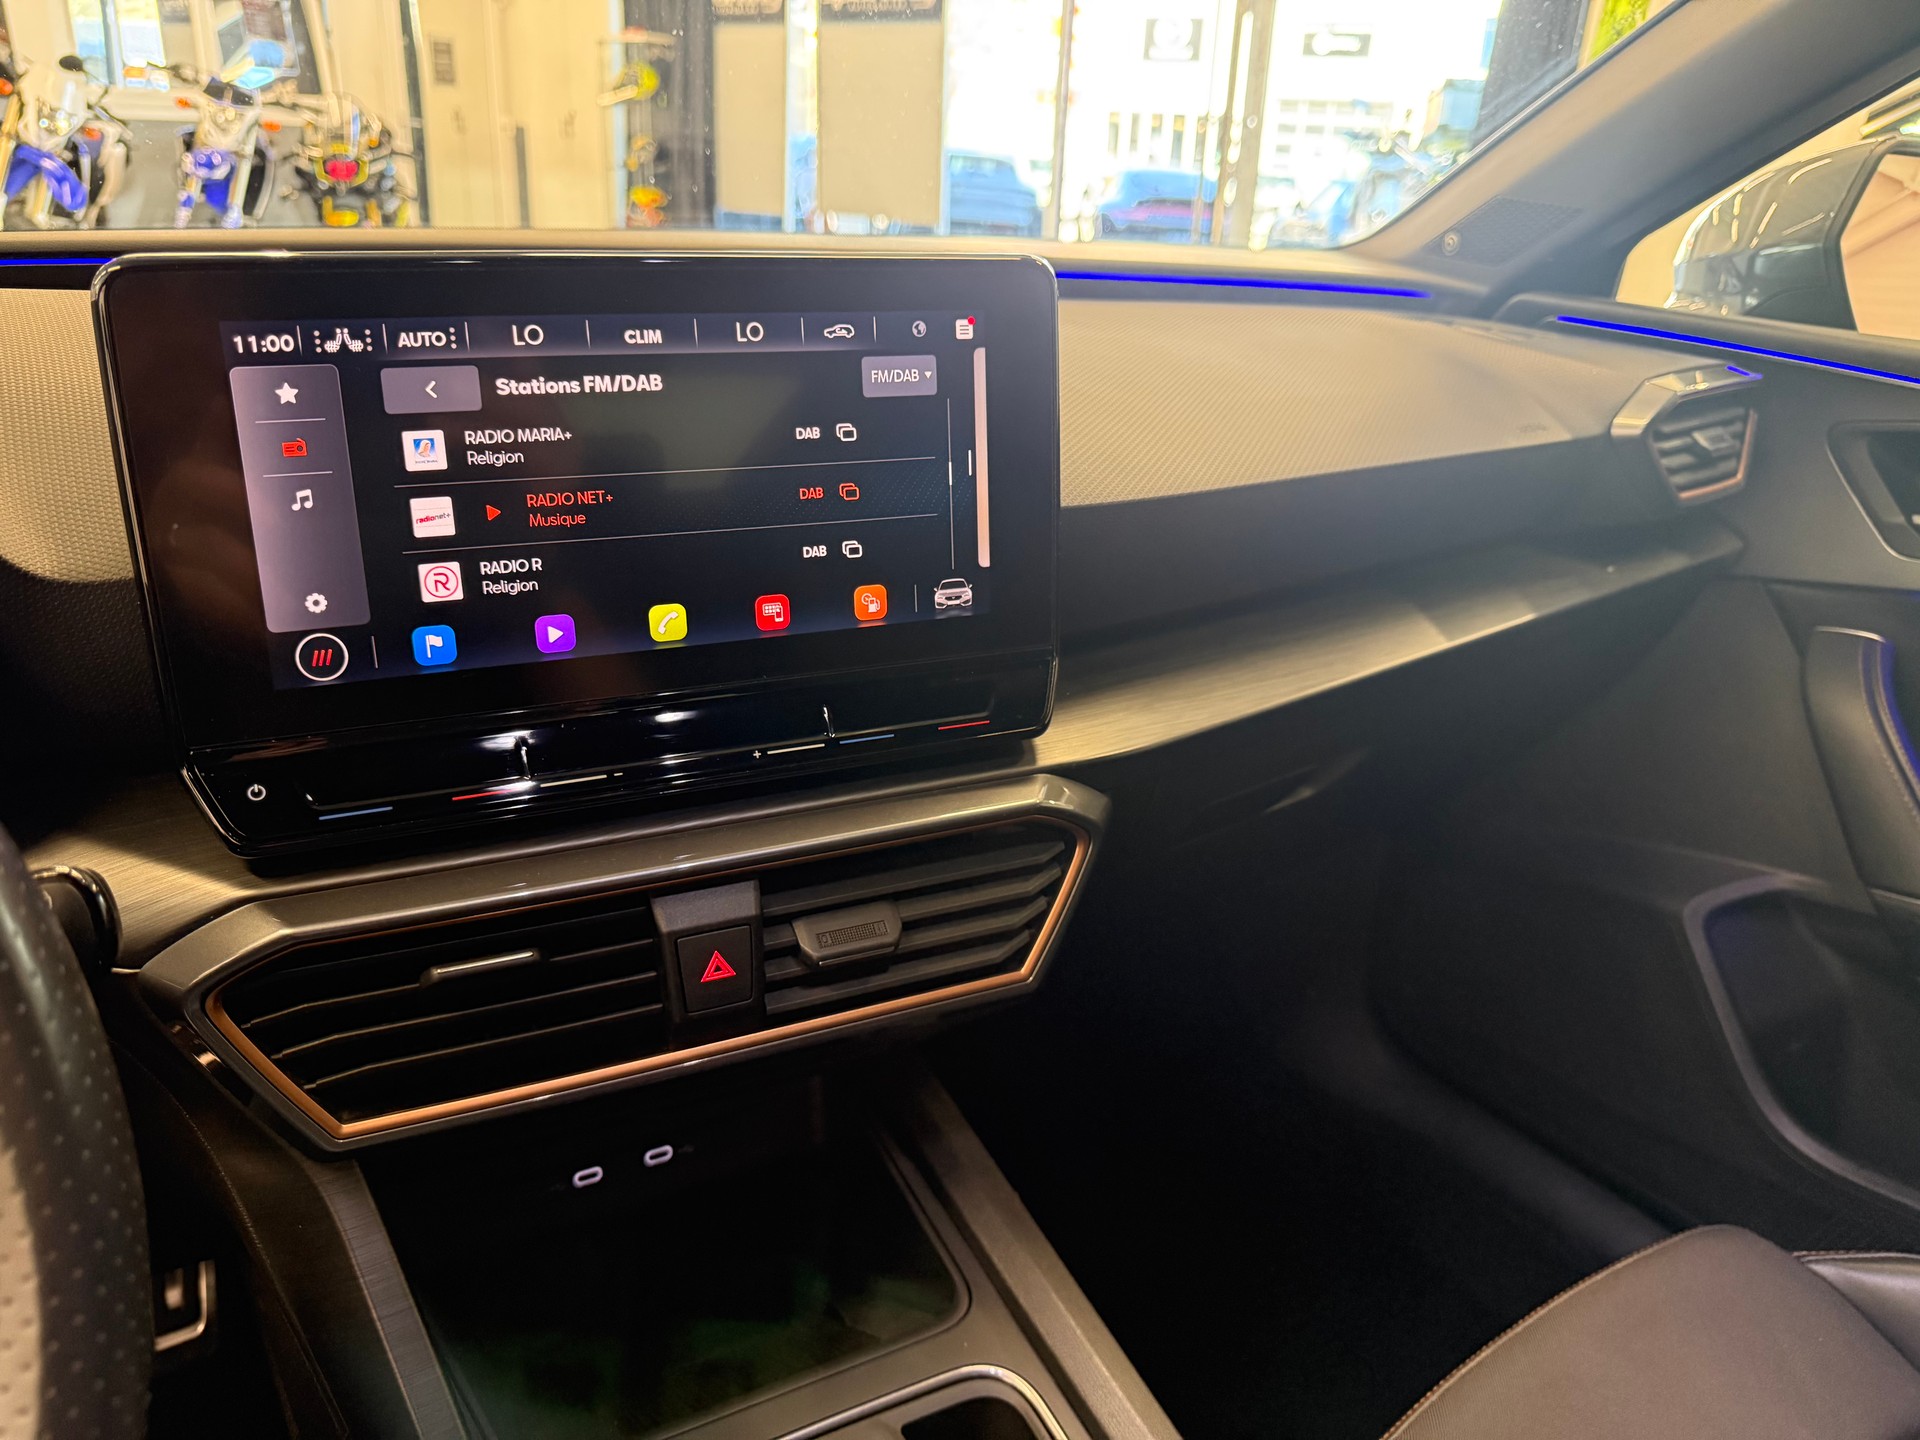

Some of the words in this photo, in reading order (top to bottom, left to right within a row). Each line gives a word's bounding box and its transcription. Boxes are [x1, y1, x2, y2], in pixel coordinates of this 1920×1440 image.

[397, 331, 447, 348] AUTO
[511, 323, 545, 346] LO
[623, 328, 663, 345] CLIM
[735, 321, 765, 342] LO
[232, 334, 295, 354] 11:00
[495, 375, 581, 397] Stations
[583, 373, 664, 394] FM/DAB
[871, 368, 920, 384] FM/DAB
[463, 428, 515, 446] RADIO
[517, 426, 573, 443] MARIA+
[795, 426, 821, 440] DAB
[466, 449, 525, 468] Religion
[526, 492, 575, 508] RADIO
[577, 489, 614, 506] NET+
[799, 487, 824, 500] DAB
[528, 511, 587, 528] Musique
[802, 545, 828, 559] DAB
[479, 559, 530, 576] RADIO
[531, 557, 543, 572] R
[481, 577, 540, 596] Religion
